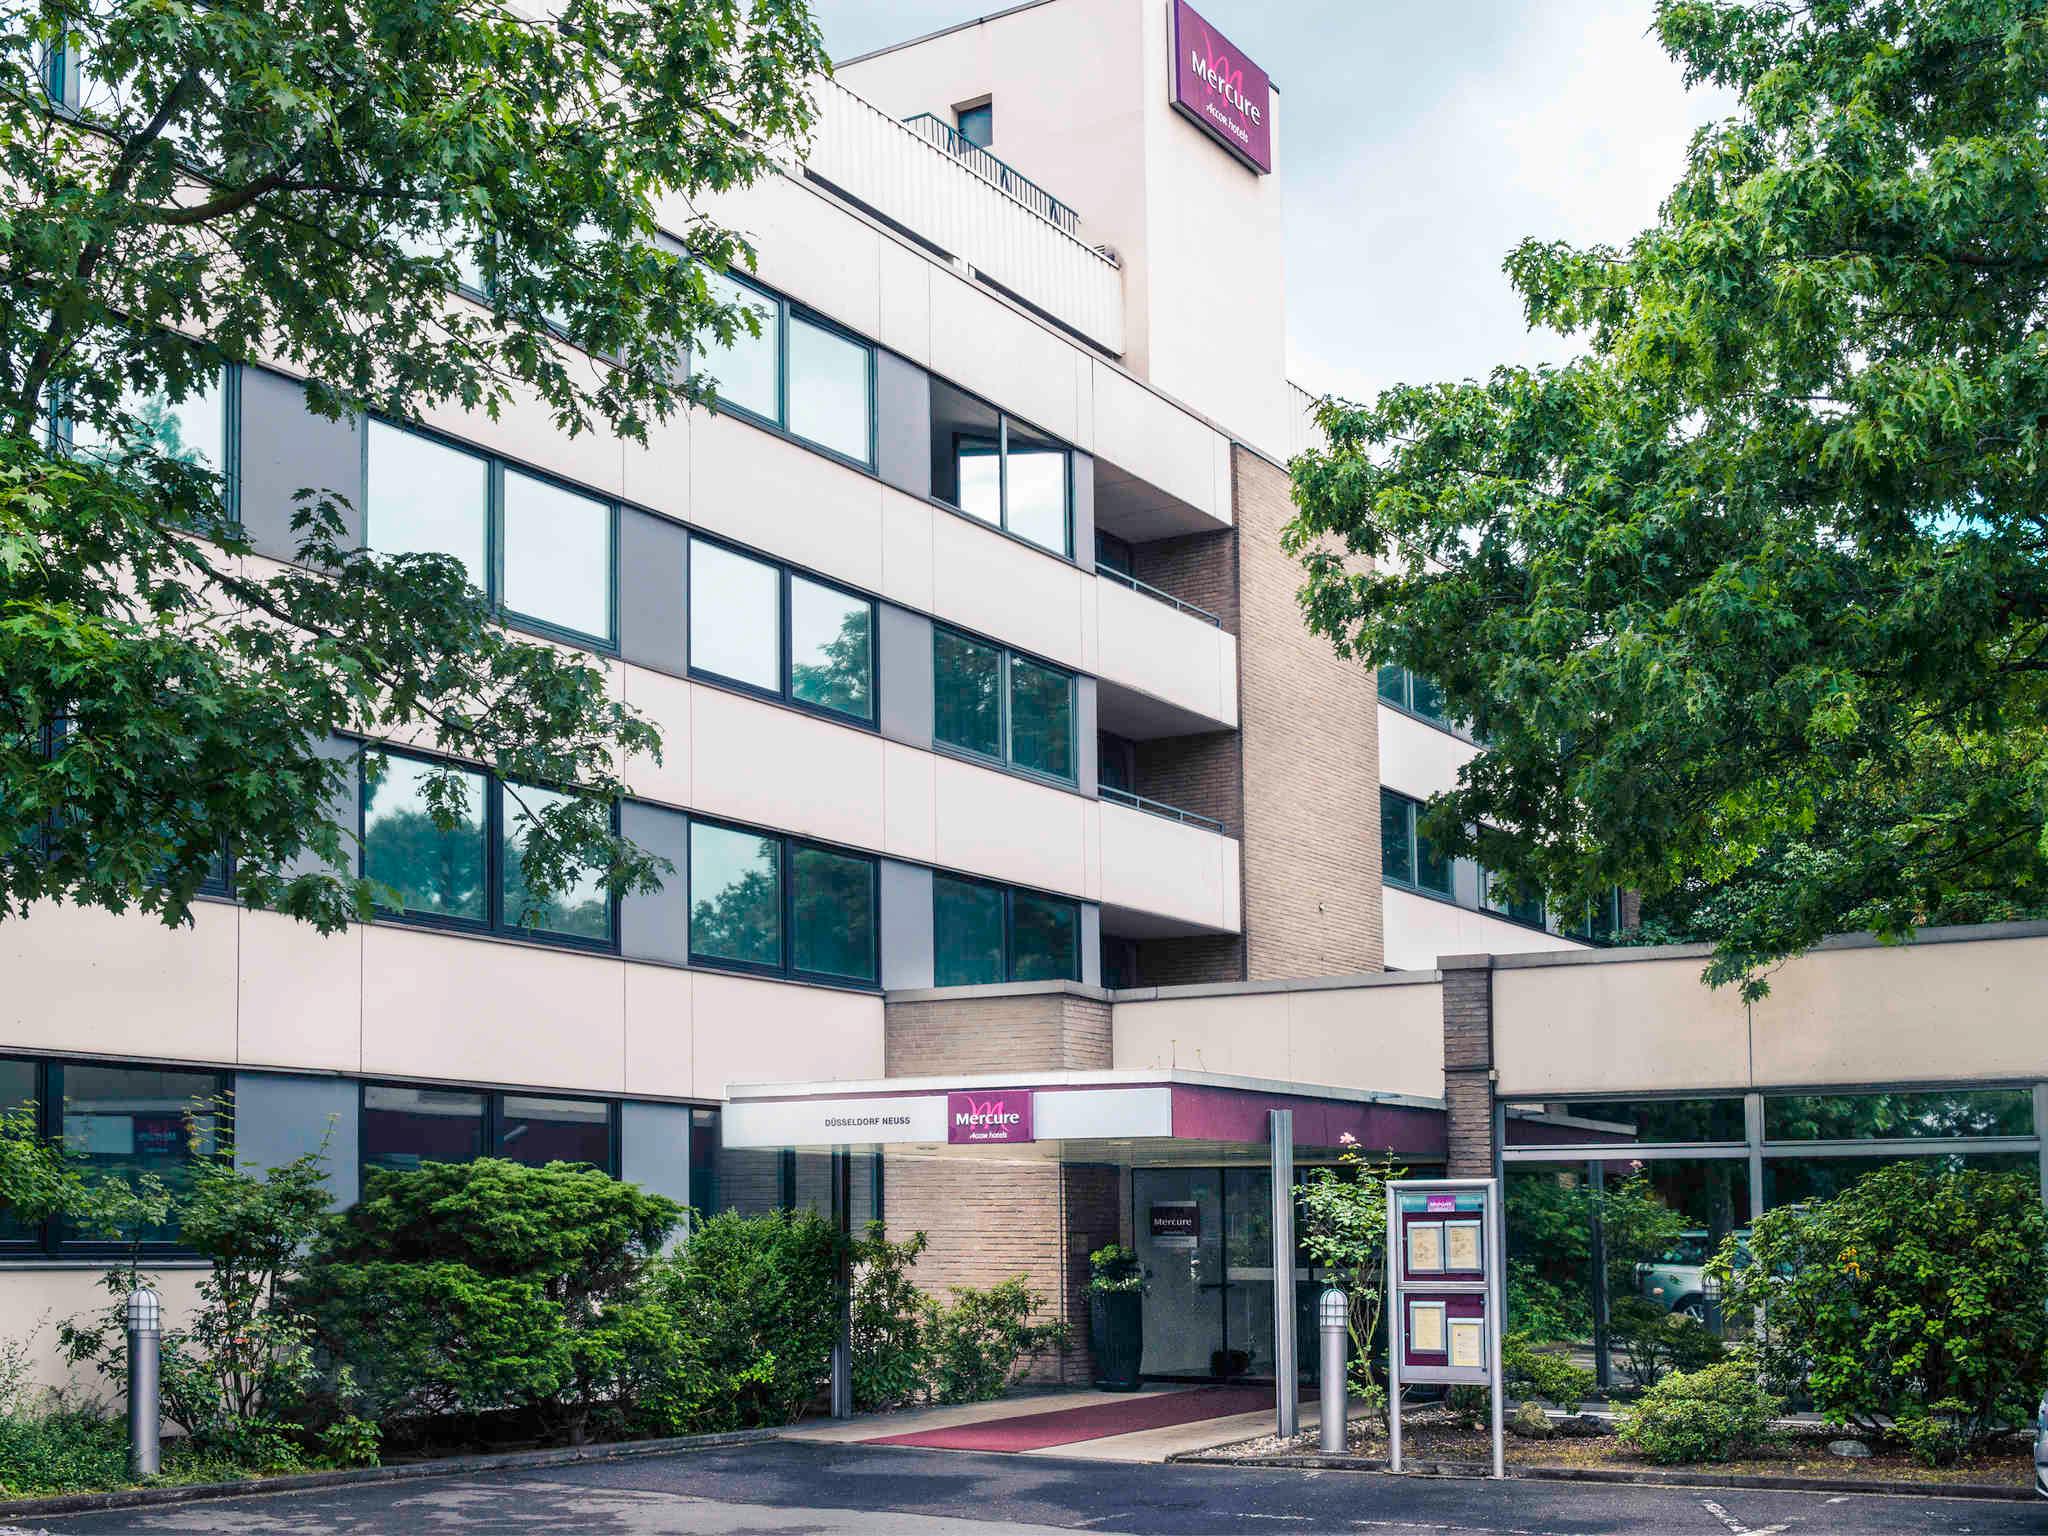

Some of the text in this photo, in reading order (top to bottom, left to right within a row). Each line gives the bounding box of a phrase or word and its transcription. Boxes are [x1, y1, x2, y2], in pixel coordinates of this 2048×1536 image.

[1191, 50, 1261, 126] Mercure
[1228, 117, 1249, 143] hotels
[824, 1116, 911, 1127] DÜSSELDORF NEUSS
[956, 1112, 1020, 1126] Mercure
[1153, 1217, 1193, 1226] Mercure
